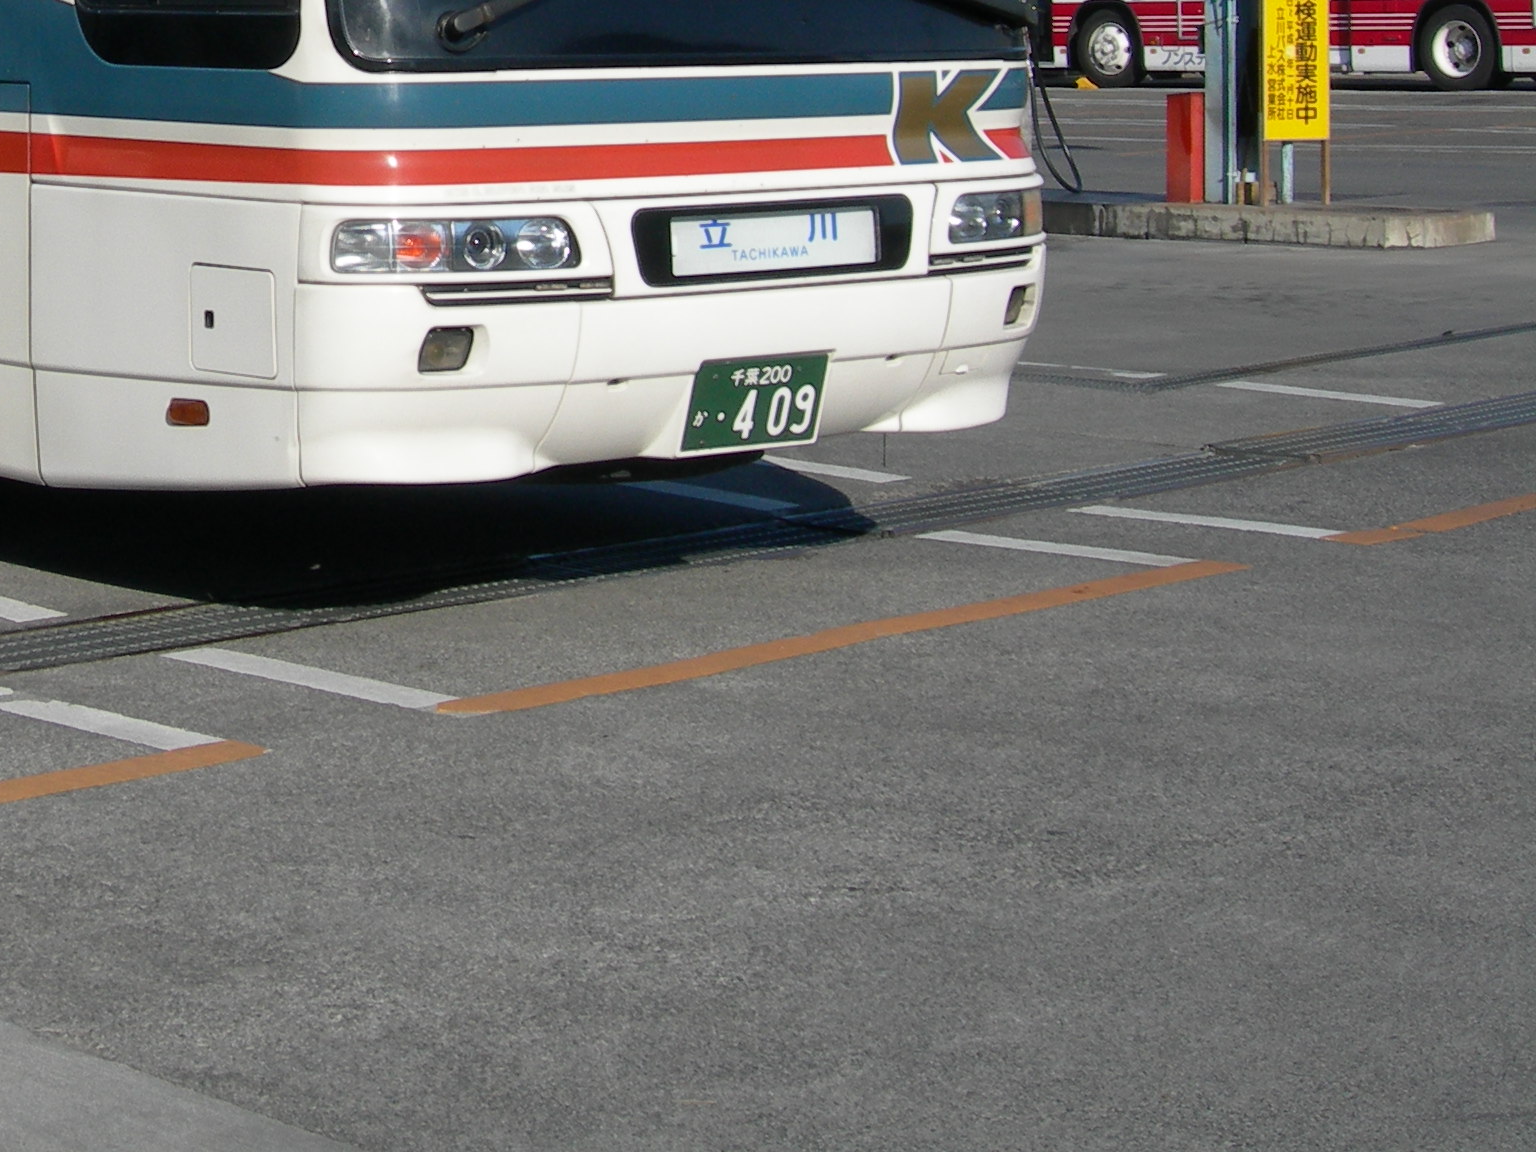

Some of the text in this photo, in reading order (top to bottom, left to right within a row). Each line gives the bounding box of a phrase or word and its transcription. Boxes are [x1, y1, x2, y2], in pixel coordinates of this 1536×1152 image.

[892, 70, 1003, 166] K
[731, 245, 809, 262] TACHIKAWA
[730, 364, 793, 387] 千葉200
